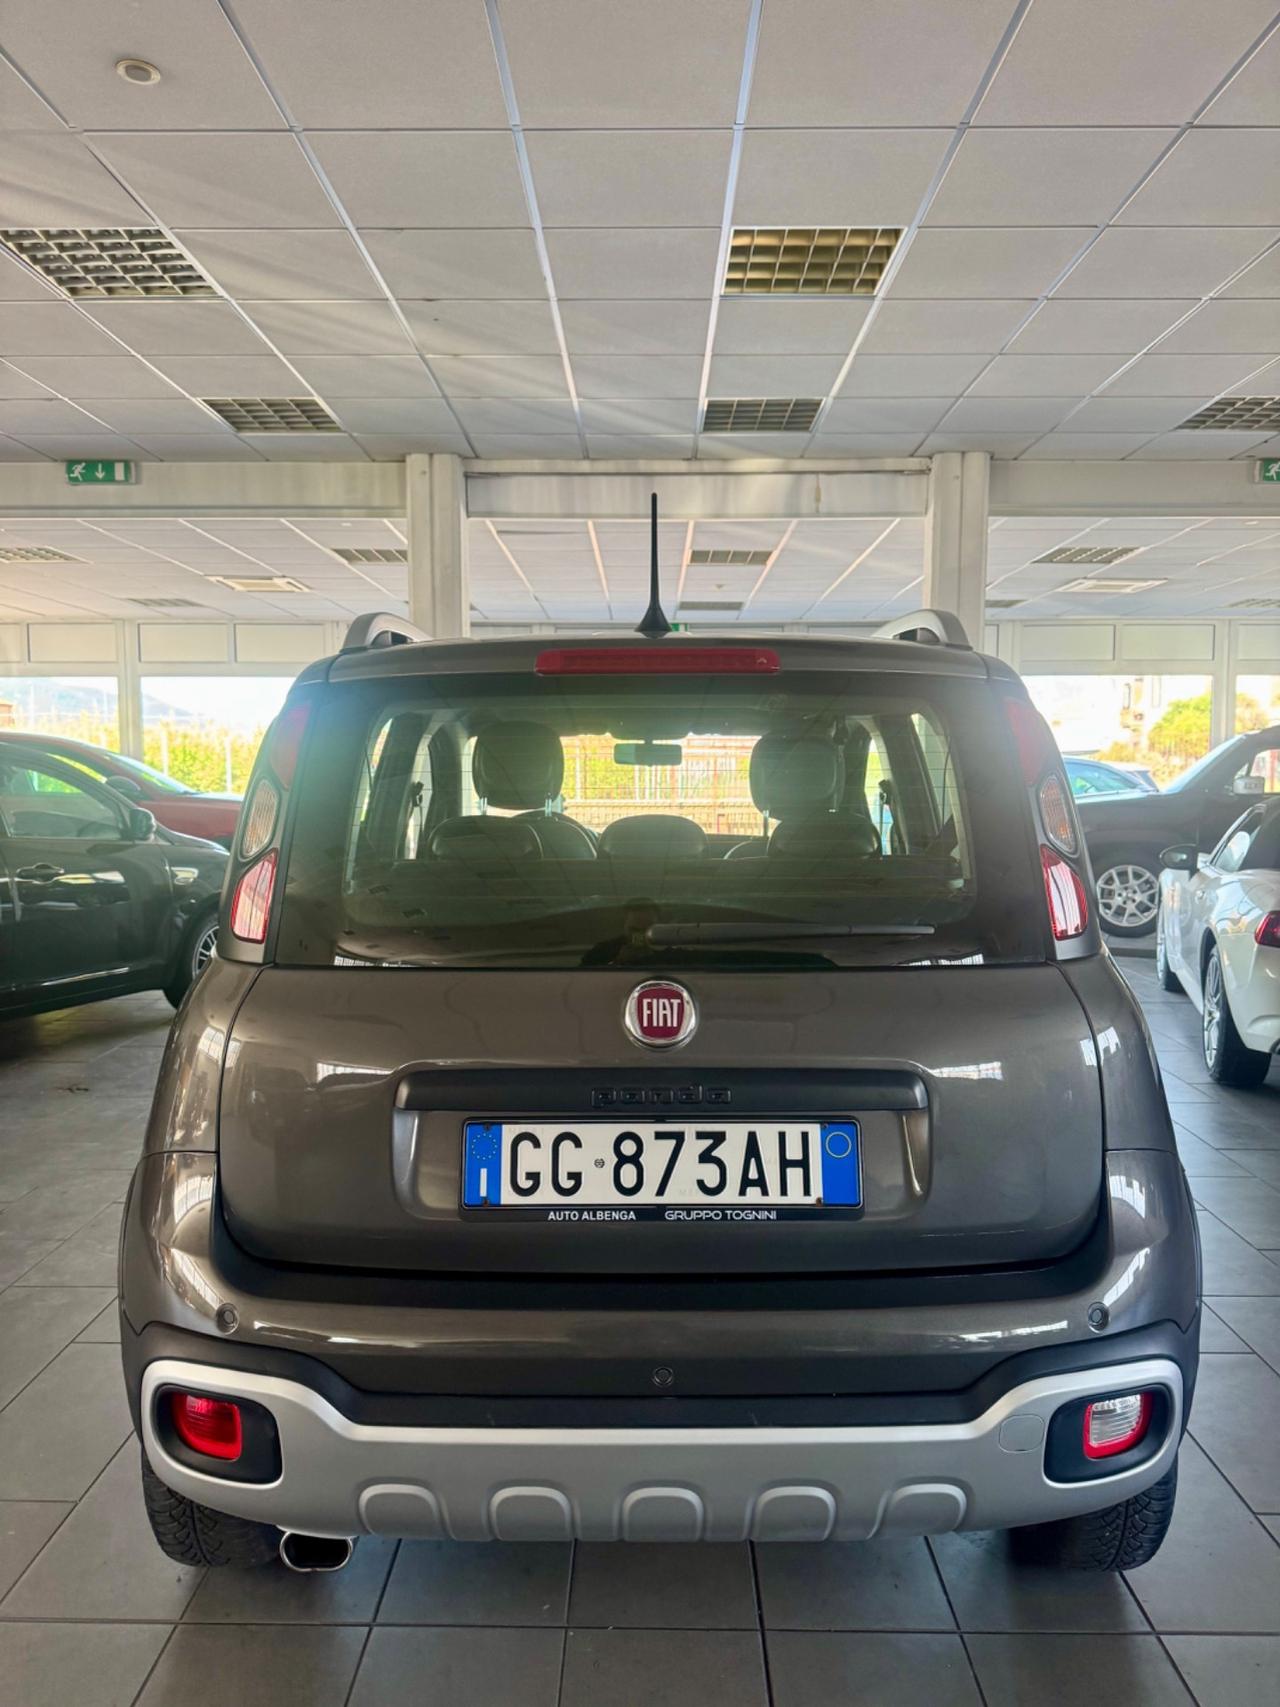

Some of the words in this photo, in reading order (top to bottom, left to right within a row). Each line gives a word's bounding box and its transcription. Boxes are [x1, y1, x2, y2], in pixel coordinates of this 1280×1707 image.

[642, 998, 681, 1027] FIAT
[509, 1131, 583, 1197] GG
[612, 1131, 812, 1197] 873AH
[548, 1210, 579, 1221] AUTO
[581, 1210, 636, 1221] ALBENGA
[664, 1210, 722, 1221] GRUPPO
[725, 1210, 777, 1221] TOGNINI
